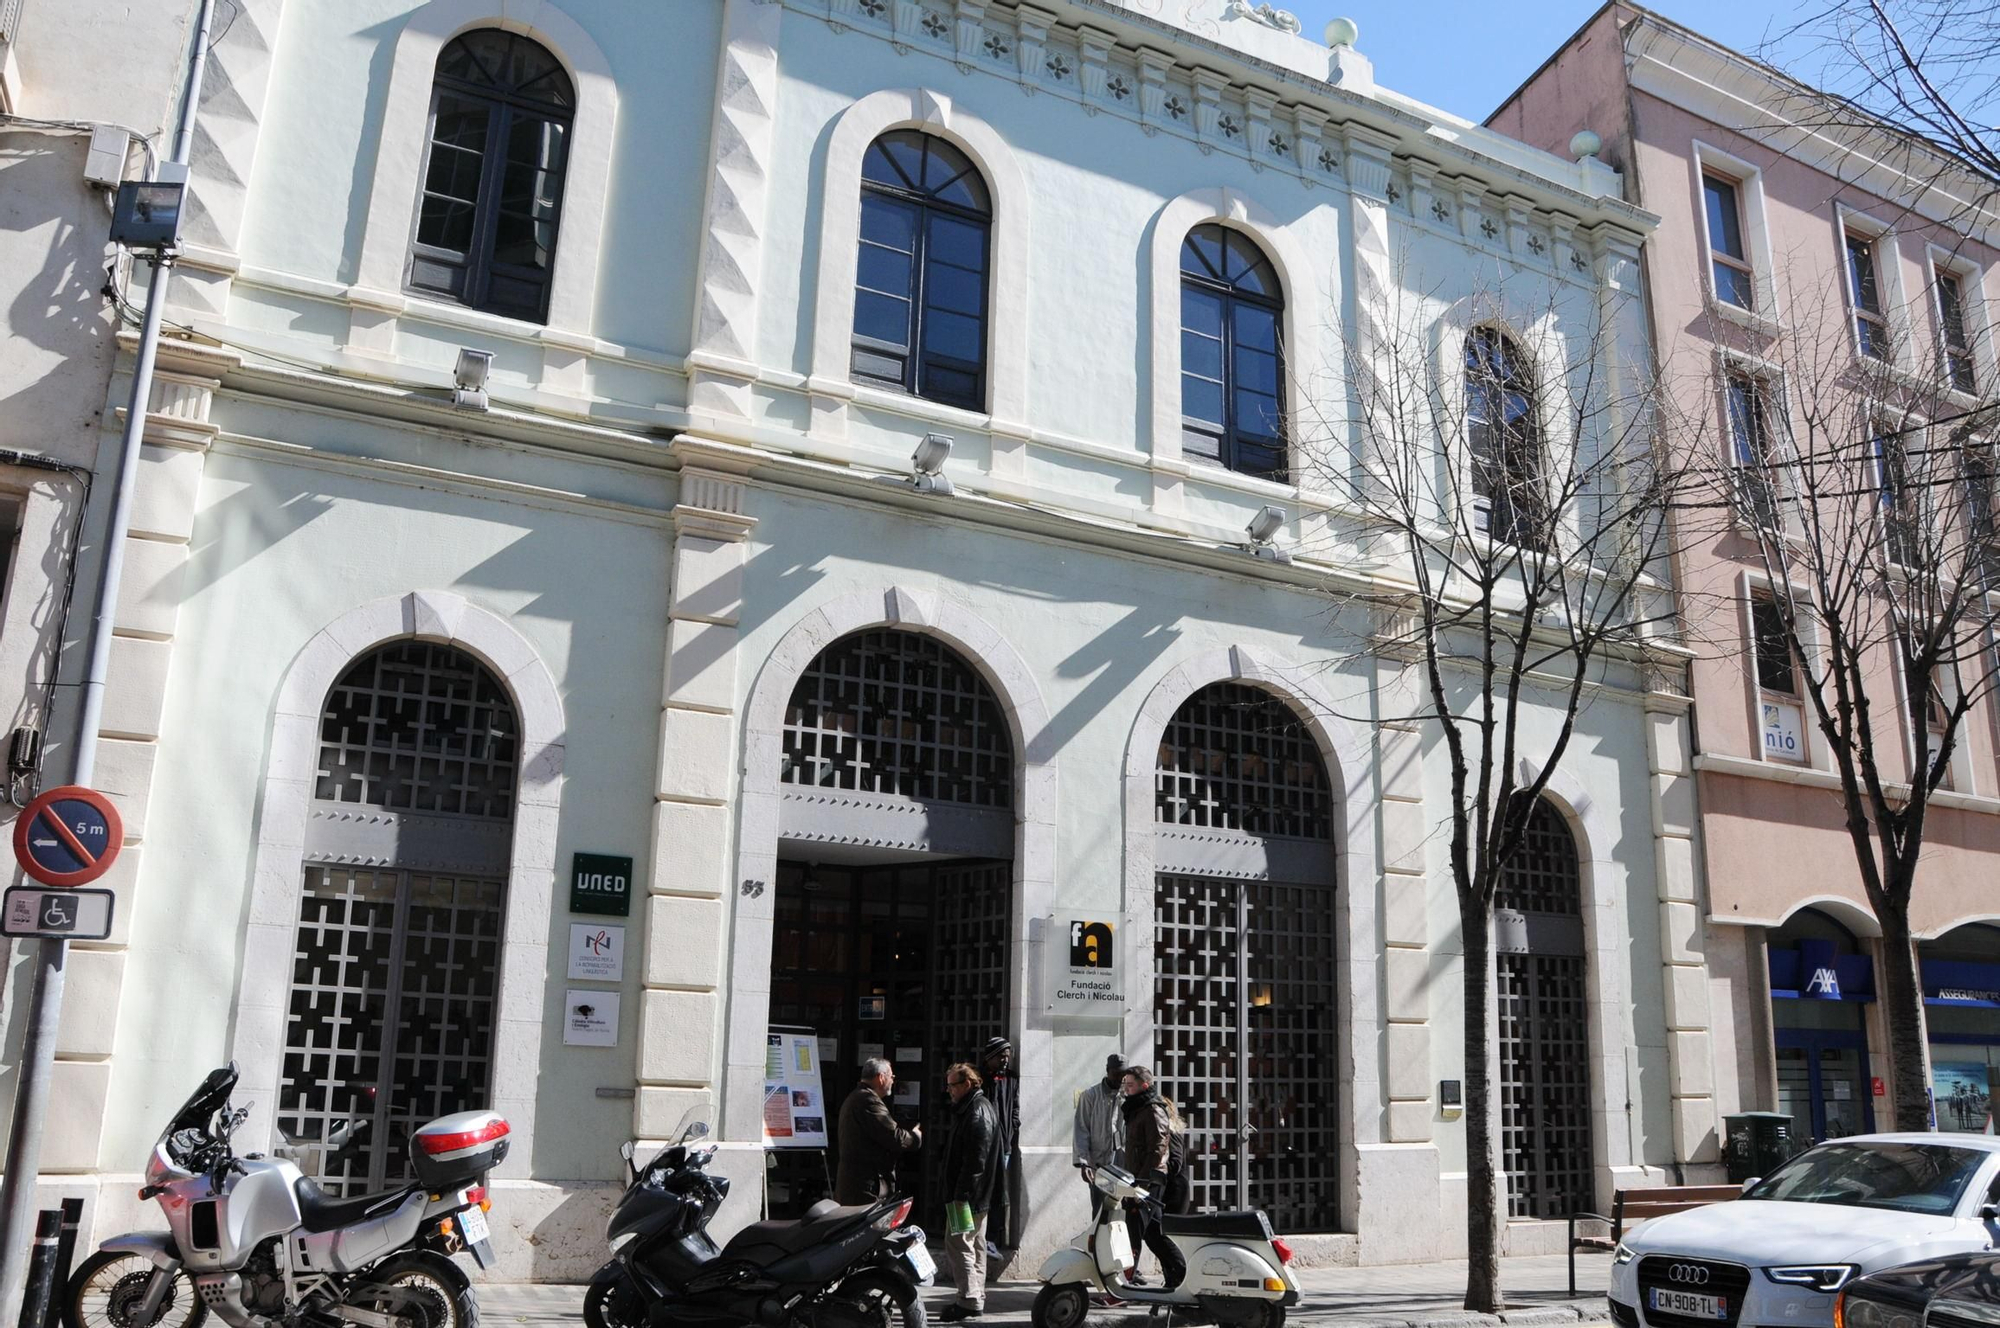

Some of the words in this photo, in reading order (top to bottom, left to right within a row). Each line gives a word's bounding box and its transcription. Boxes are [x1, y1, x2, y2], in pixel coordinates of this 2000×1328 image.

[75, 822, 86, 835] 5
[90, 825, 104, 835] m
[577, 872, 626, 892] UNED
[1071, 980, 1111, 991] Fundació
[1806, 968, 1840, 993] AXA
[1057, 990, 1086, 1000] Clerch
[1088, 991, 1091, 1000] i
[1092, 993, 1125, 1002] Nicolau
[1658, 1292, 1716, 1315] CN-908-TL
